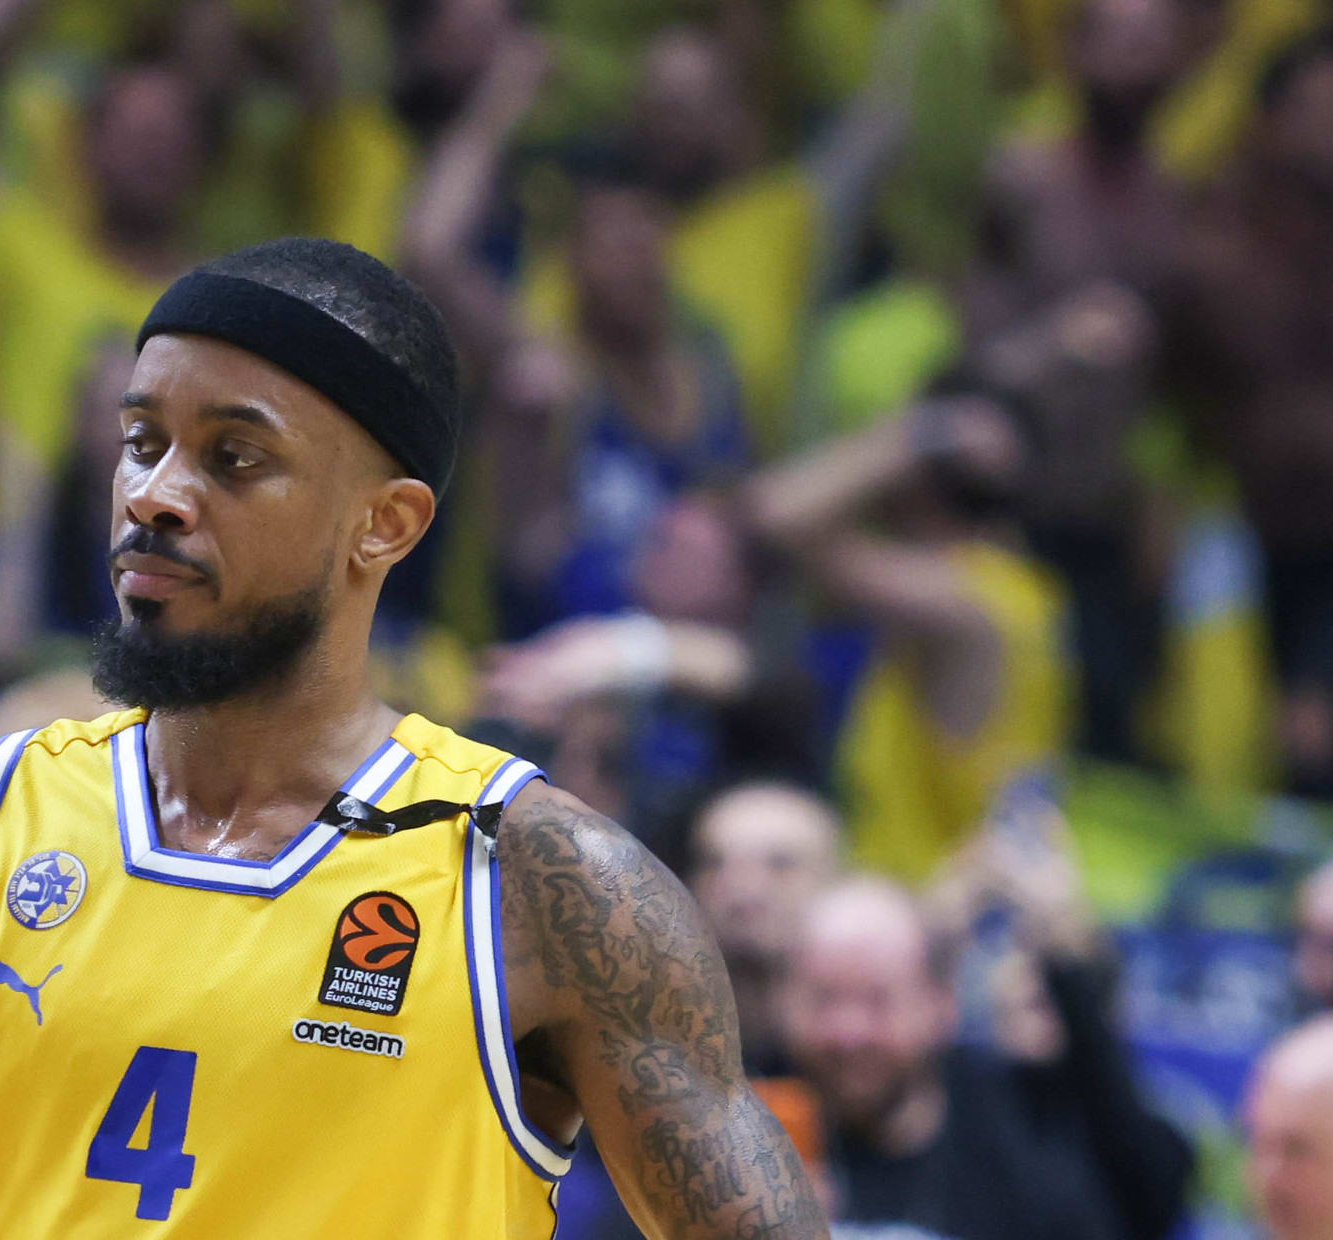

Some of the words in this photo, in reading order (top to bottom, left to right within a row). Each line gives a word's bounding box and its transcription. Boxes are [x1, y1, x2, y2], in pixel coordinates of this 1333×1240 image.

[333, 967, 401, 989] TURKISH
[325, 991, 394, 1011] EuroLeague
[328, 980, 398, 1001] AIRLINES
[294, 1020, 404, 1057] oneteam
[85, 1045, 198, 1222] 4
